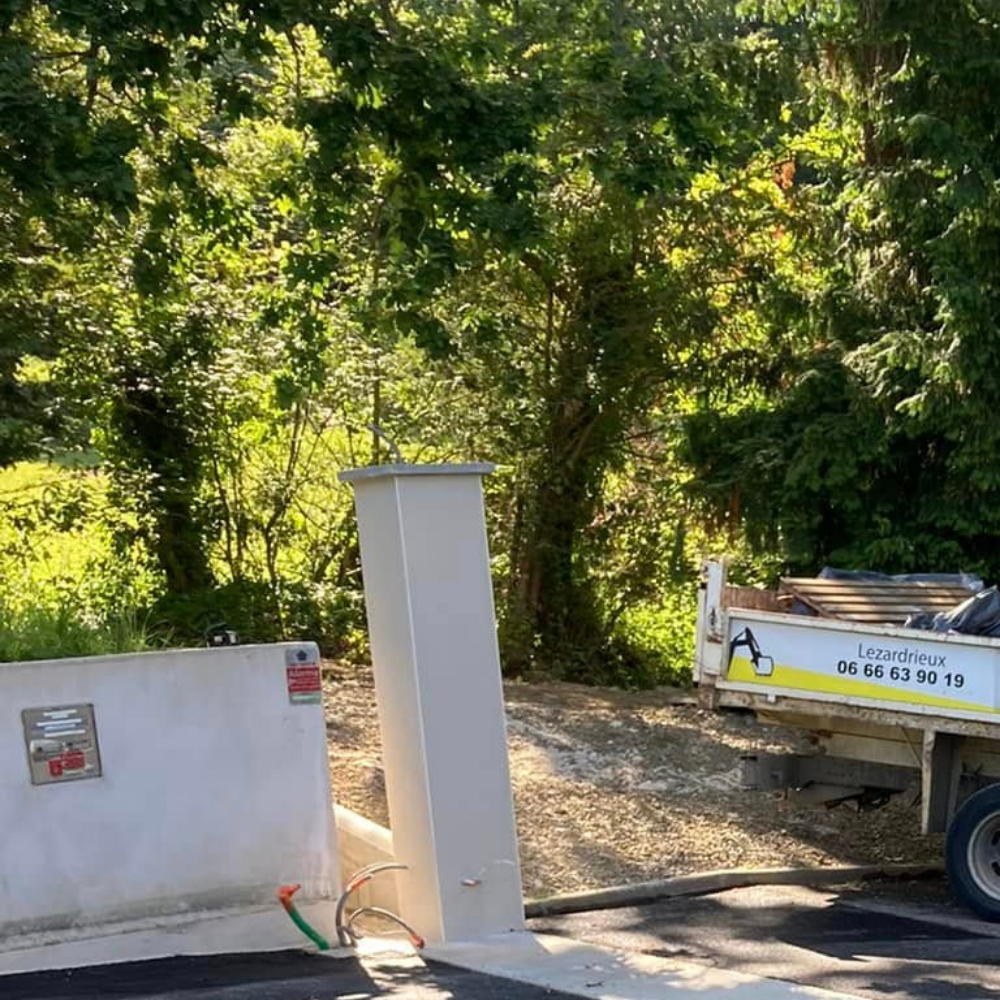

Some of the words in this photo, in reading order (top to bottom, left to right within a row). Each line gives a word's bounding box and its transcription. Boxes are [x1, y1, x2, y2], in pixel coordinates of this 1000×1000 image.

[858, 643, 946, 667] Lezardrieux
[837, 660, 858, 675] 06
[863, 663, 884, 678] 66
[890, 666, 911, 681] 63
[916, 670, 937, 685] 90
[944, 673, 965, 687] 19
